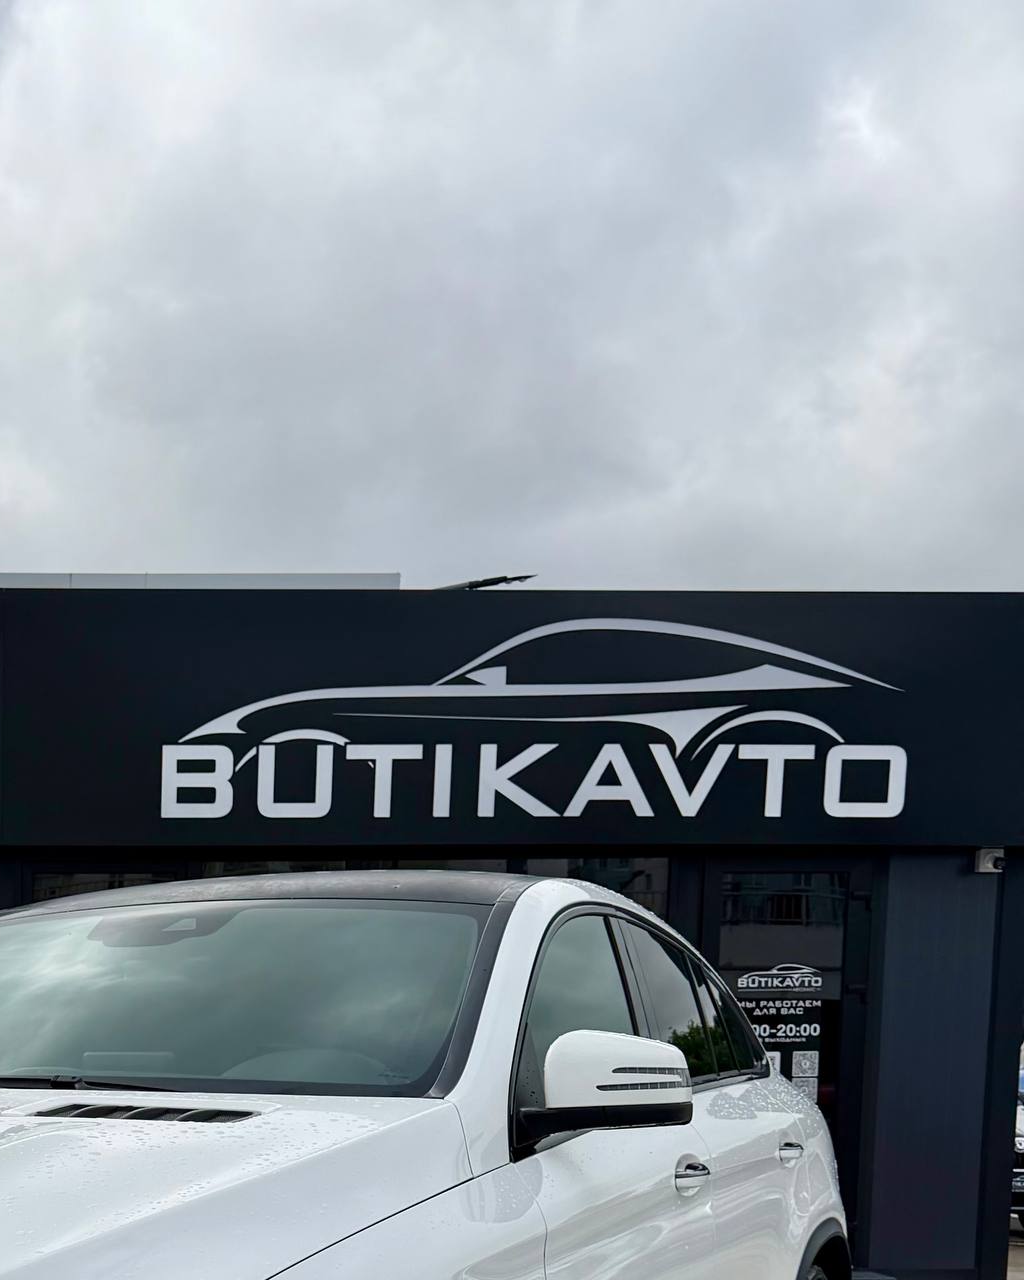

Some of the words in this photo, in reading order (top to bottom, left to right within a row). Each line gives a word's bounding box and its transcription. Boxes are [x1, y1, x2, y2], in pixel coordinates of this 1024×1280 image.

[161, 742, 908, 819] BUTIKAVTO
[737, 976, 823, 988] BUTIKAVTO
[760, 1000, 822, 1008] РАБОТАЕМ
[753, 1008, 777, 1016] ДЛЯ
[753, 1023, 821, 1037] 00-20:00
